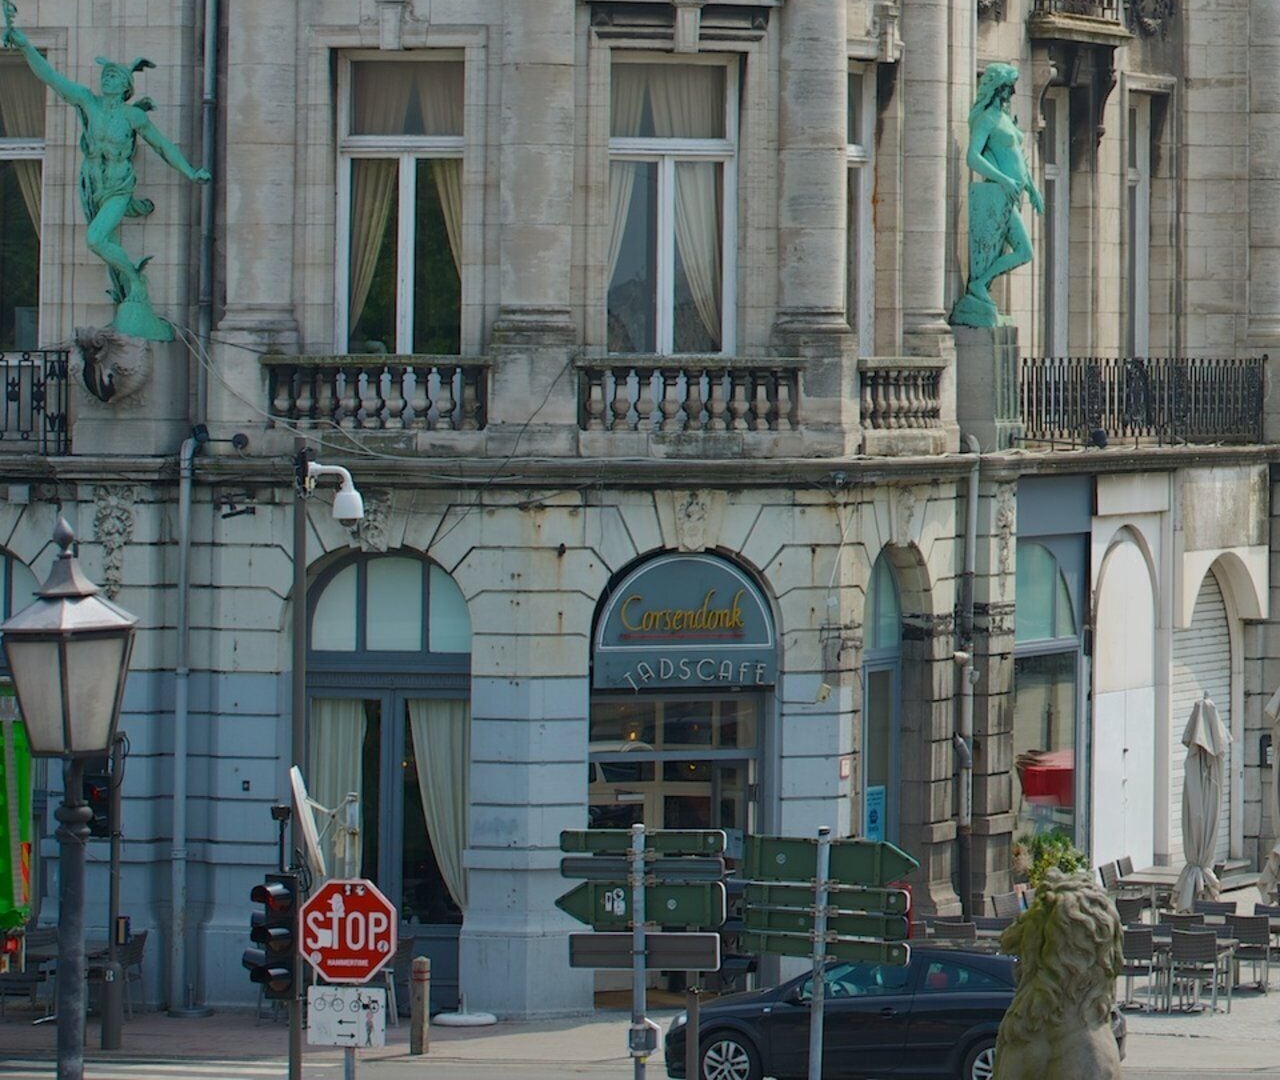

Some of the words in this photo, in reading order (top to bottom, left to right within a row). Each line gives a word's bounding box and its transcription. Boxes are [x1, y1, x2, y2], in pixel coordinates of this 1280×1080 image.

[620, 588, 746, 632] Corsendonk
[306, 911, 389, 951] STOP
[327, 958, 369, 967] HAMMERTIME
